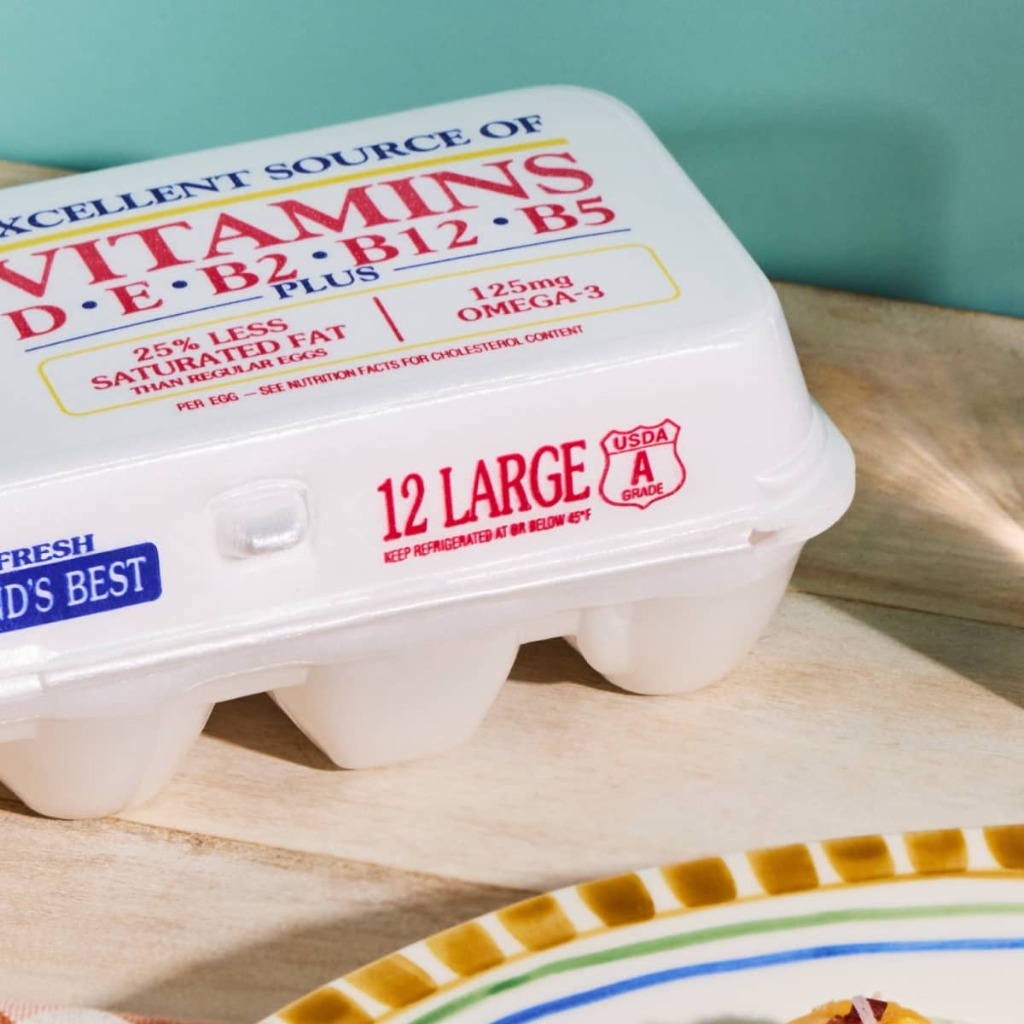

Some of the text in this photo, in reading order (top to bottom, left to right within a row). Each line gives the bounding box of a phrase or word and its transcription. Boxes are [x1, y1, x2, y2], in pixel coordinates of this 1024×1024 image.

[264, 128, 471, 181] SOURCE
[479, 115, 543, 140] OF
[1, 195, 616, 341] D E B2 B12 B5
[271, 265, 380, 299] PLUS
[468, 275, 574, 301] 125mg
[457, 284, 605, 322] OMEGA-3
[91, 324, 347, 390] SATURATED FAT
[133, 318, 290, 362] 25% LESS
[130, 348, 328, 396] THAN REGULAR EGGS
[176, 324, 584, 412] PER EGG SEE NUTRITION FACTS FOR CHOLESTEROL CONTENT
[613, 428, 668, 450] USDA
[378, 440, 591, 542] 12 LARGE
[630, 450, 654, 485] A
[621, 483, 664, 502] GRADE
[384, 546, 411, 563] KEEP
[414, 527, 493, 557] REFRIGERATED
[494, 525, 508, 540] AT
[509, 522, 526, 537] OR
[529, 514, 565, 533] BELOW
[65, 556, 147, 606] BEST
